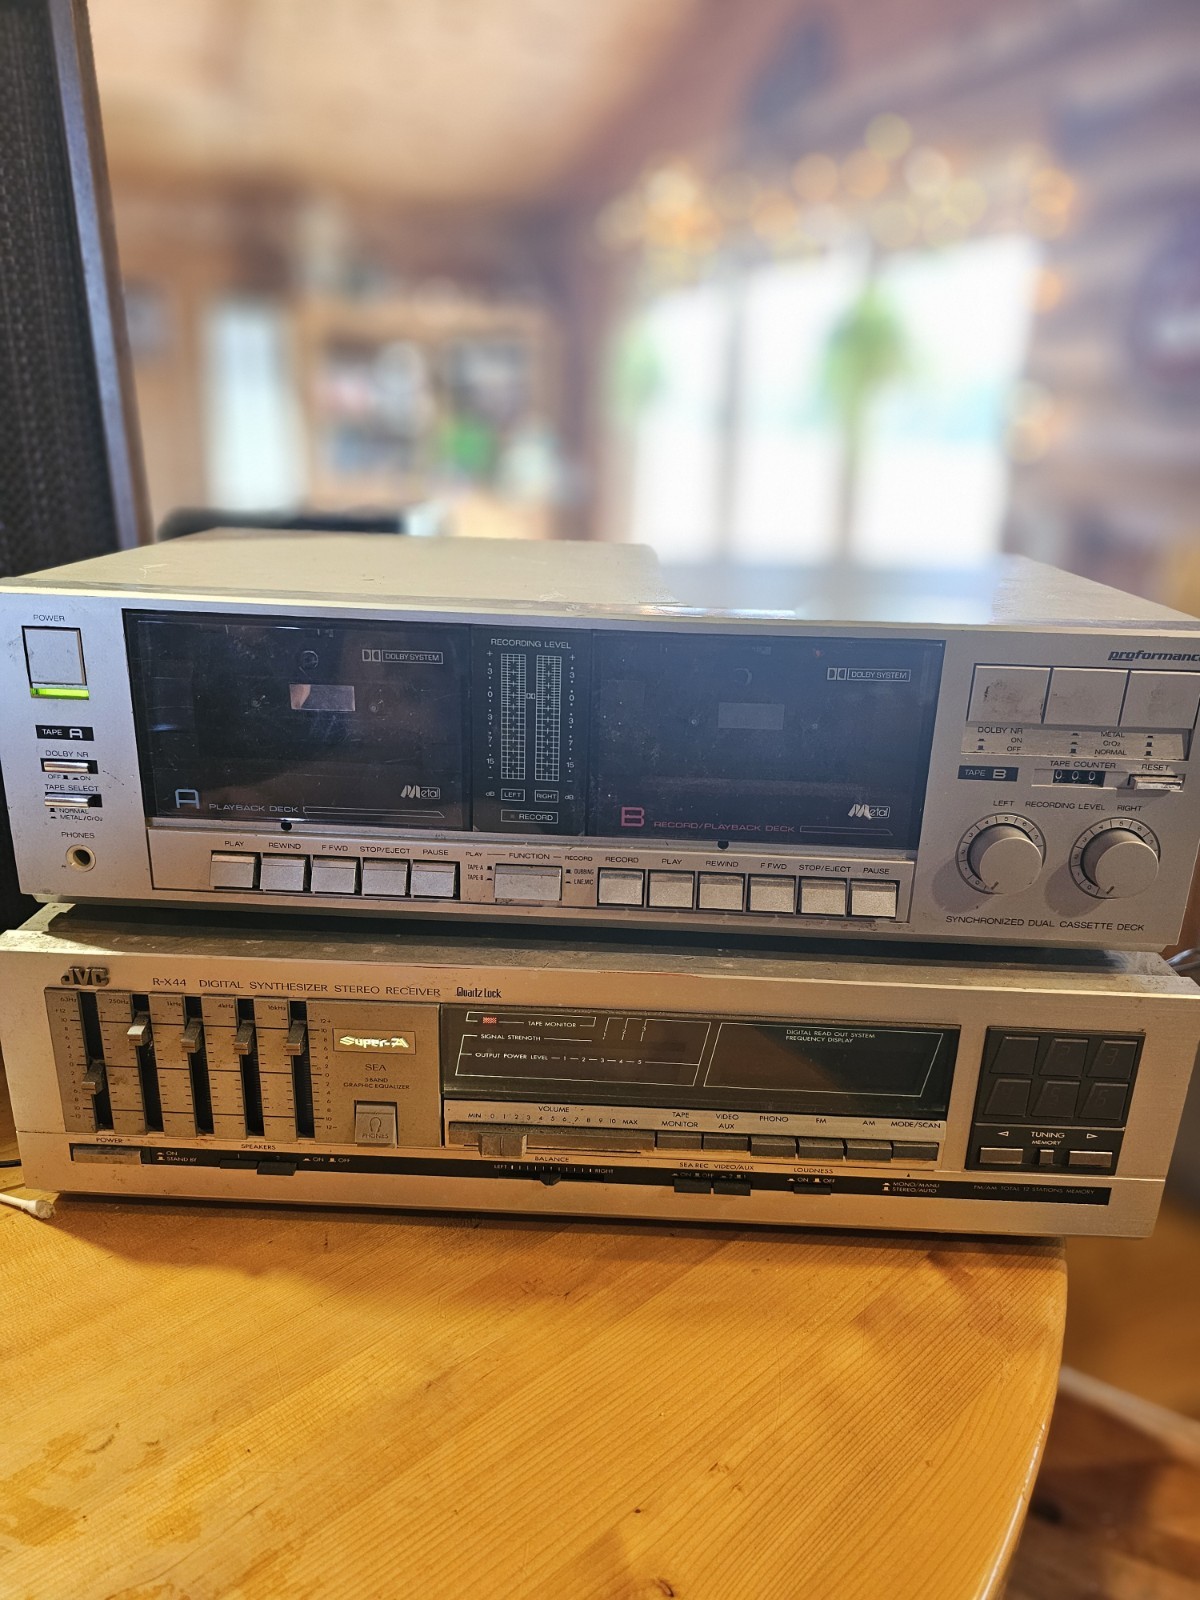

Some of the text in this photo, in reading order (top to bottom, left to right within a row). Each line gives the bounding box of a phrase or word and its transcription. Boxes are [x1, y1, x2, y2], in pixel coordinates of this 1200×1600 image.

[490, 638, 572, 649] RECORDING LEVEL
[410, 654, 440, 662] SYSTEM
[1108, 650, 1200, 662] proformanc
[69, 728, 83, 738] A
[1074, 760, 1116, 769] COUNTER
[964, 768, 1006, 779] TAPE B
[400, 785, 440, 800] Metal
[174, 788, 200, 810] A
[208, 803, 299, 813] PLAYBACK DECK
[1025, 801, 1075, 809] RECORDING
[620, 806, 645, 827] B
[848, 804, 890, 819] Metal
[654, 821, 761, 831] RECORD/PLAYBACK
[360, 846, 410, 854] STOP/EJECT
[705, 860, 738, 868] REWIND
[798, 864, 851, 873] STOP/EJECT
[946, 916, 1024, 926] SYNCHRONIZED
[1028, 920, 1055, 928] DUAL
[1060, 921, 1113, 930] CASSETTE
[61, 966, 110, 986] JVC
[153, 978, 502, 999] R-X44 DIGITAL SYNTHESIZER STEREO RECEIVER Quartz Lock
[339, 1035, 409, 1048] Super-A
[890, 1121, 941, 1129] MODE/SCAN
